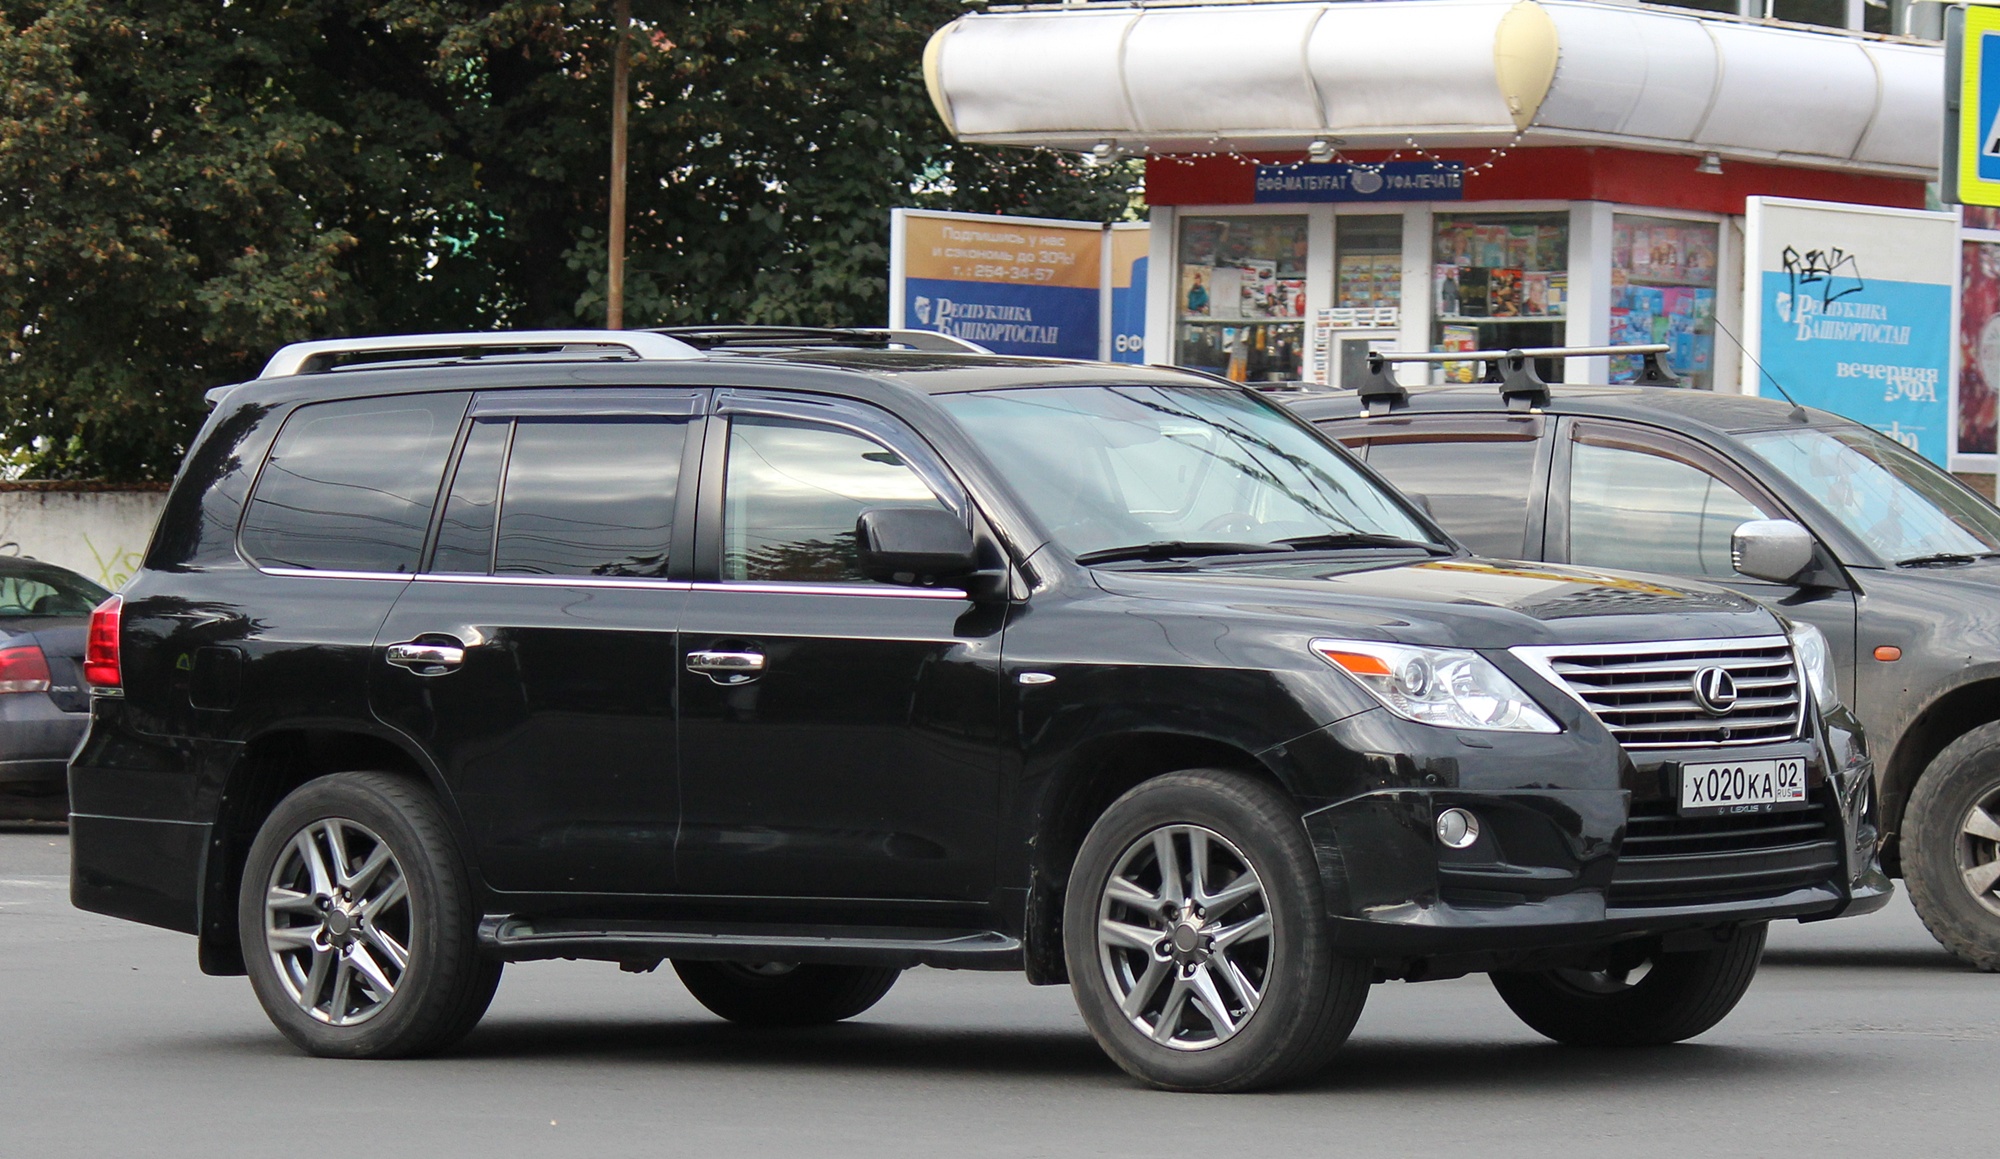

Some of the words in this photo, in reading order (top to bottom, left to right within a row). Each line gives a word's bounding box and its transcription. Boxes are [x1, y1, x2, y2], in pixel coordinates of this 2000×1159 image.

[1386, 173, 1462, 189] УФА-ПЕЧАТЬ
[942, 226, 1026, 245] Подпишись
[1029, 235, 1036, 248] у
[1039, 235, 1066, 247] нас
[931, 248, 942, 258] и
[944, 248, 1014, 261] сэкономь
[1016, 251, 1036, 264] до
[1039, 250, 1075, 266] 30%!
[974, 264, 1055, 282] 254-34-57
[1115, 334, 1146, 353] ӨФ
[1836, 362, 1939, 386] вечерняя
[1890, 376, 1938, 402] УФА
[1692, 767, 1773, 802] Х020КА
[1778, 762, 1798, 788] 02
[1778, 788, 1791, 798] RUS
[1730, 804, 1759, 814] LEXUS
